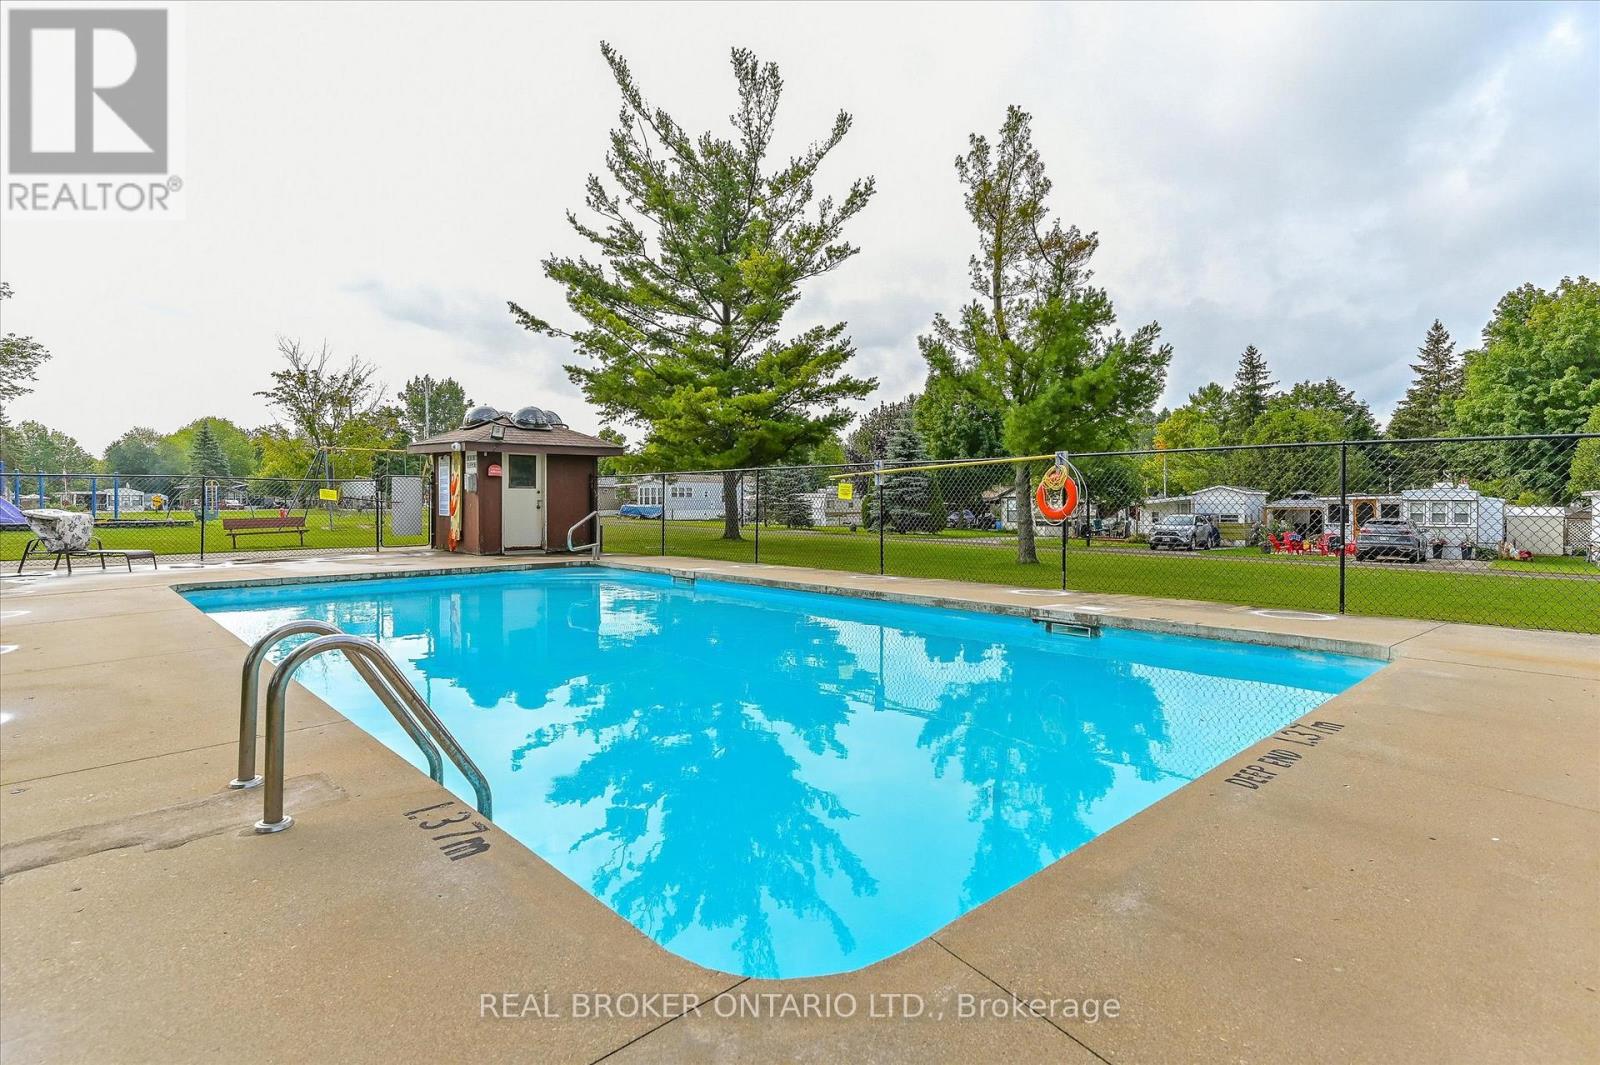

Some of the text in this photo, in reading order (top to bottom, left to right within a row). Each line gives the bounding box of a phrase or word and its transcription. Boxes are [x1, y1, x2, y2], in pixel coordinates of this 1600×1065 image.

[1224, 721, 1345, 790] DEEP END 1.37m
[402, 801, 491, 861] 1.37m
